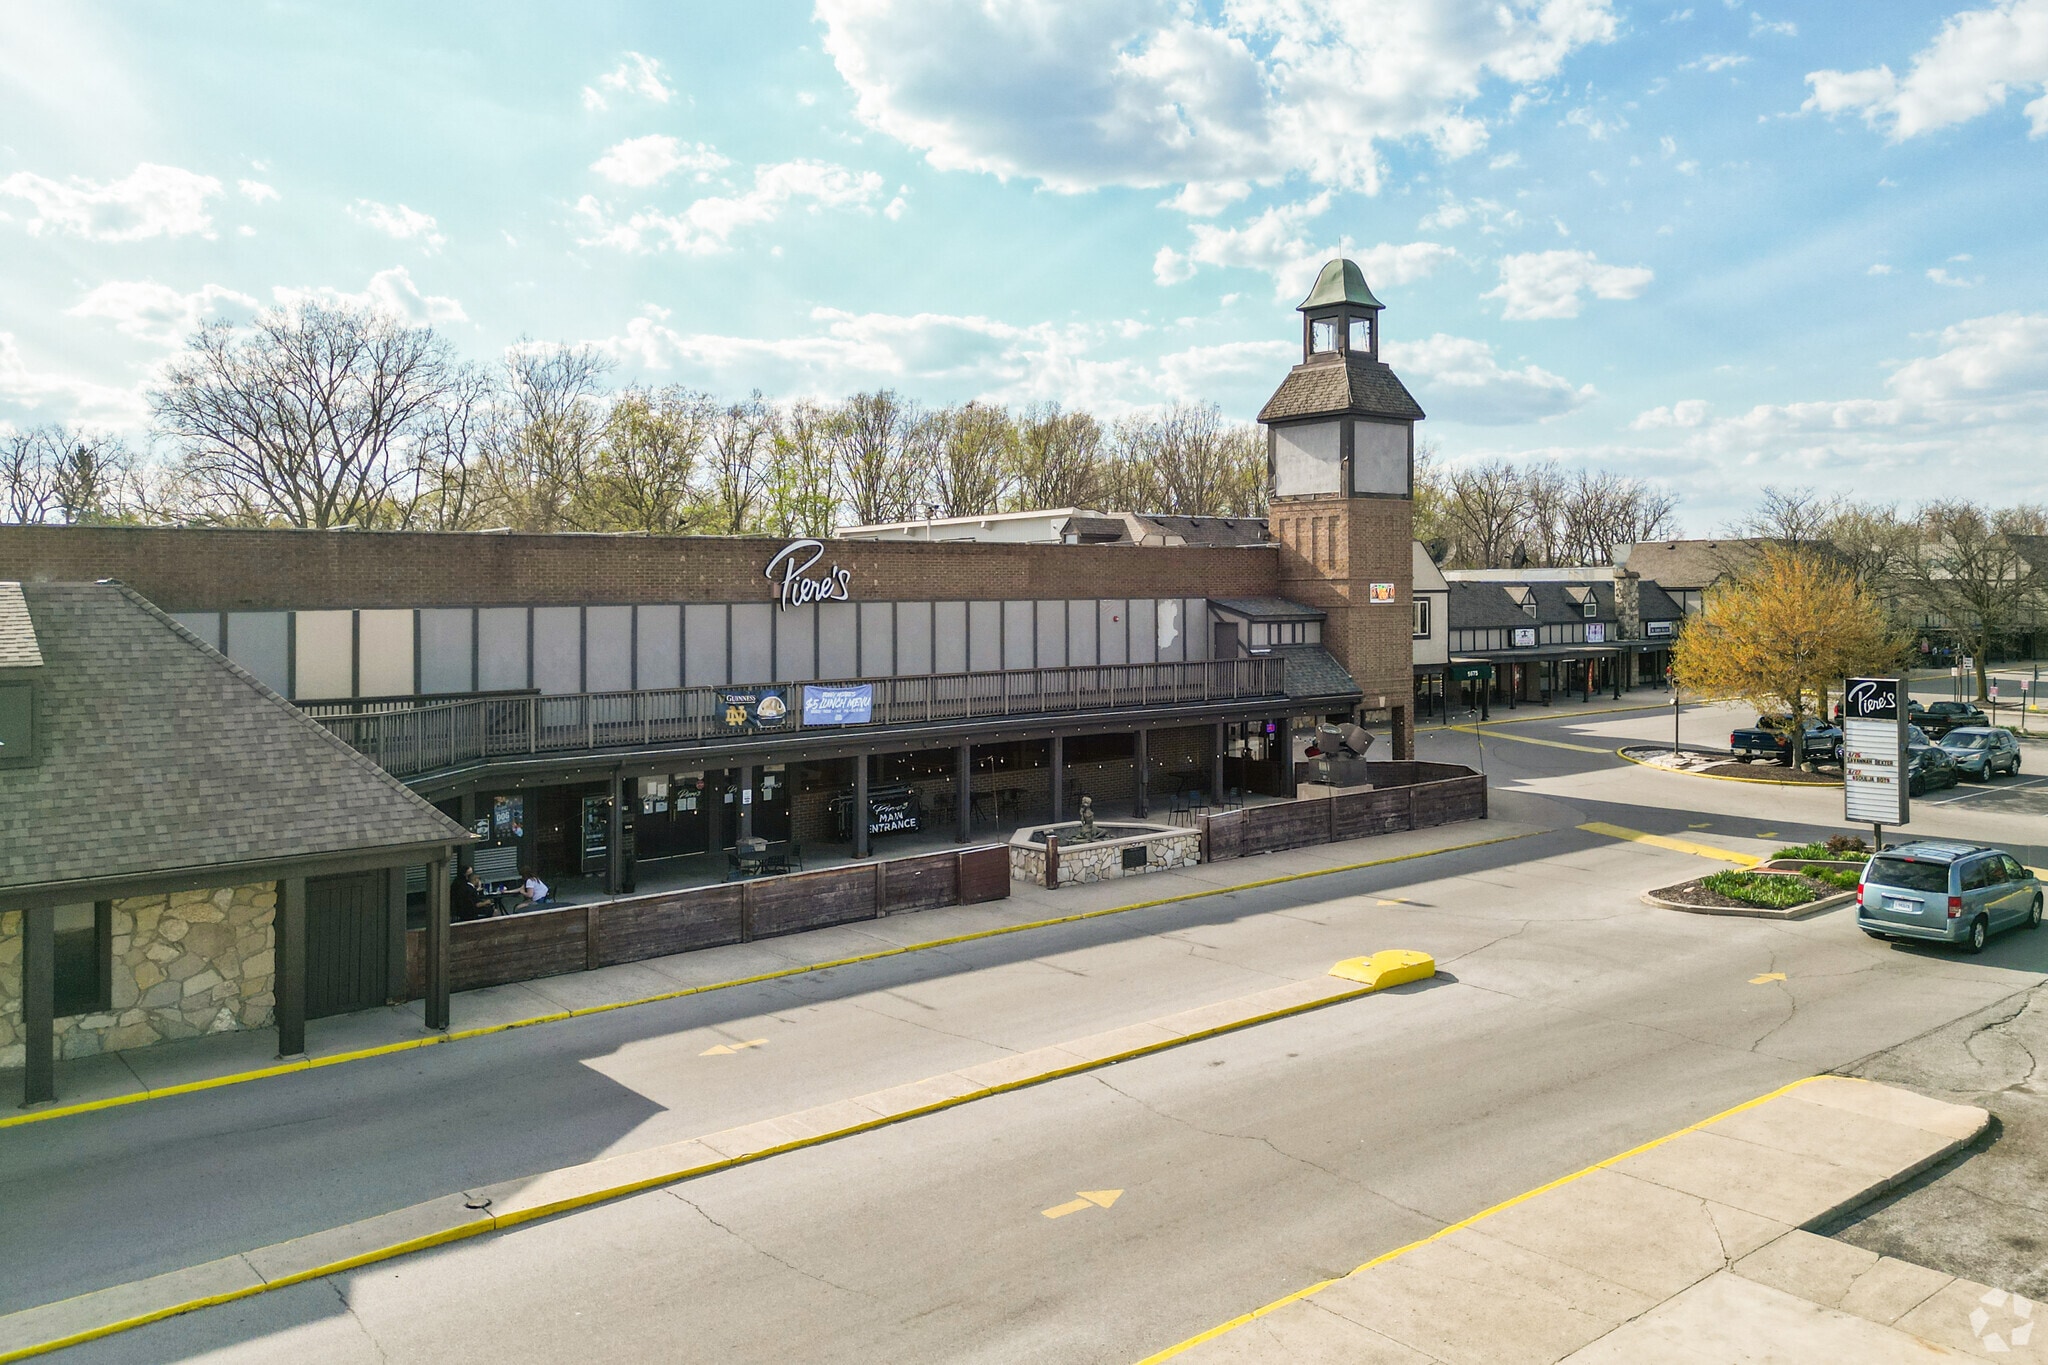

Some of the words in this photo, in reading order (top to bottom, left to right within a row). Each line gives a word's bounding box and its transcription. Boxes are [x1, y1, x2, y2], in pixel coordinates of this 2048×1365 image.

[765, 540, 850, 612] Piere's
[805, 697, 820, 711] $5
[818, 698, 846, 710] LUNCH
[847, 696, 871, 710] MENU
[1848, 681, 1895, 716] Piere's
[879, 812, 904, 823] MAIN
